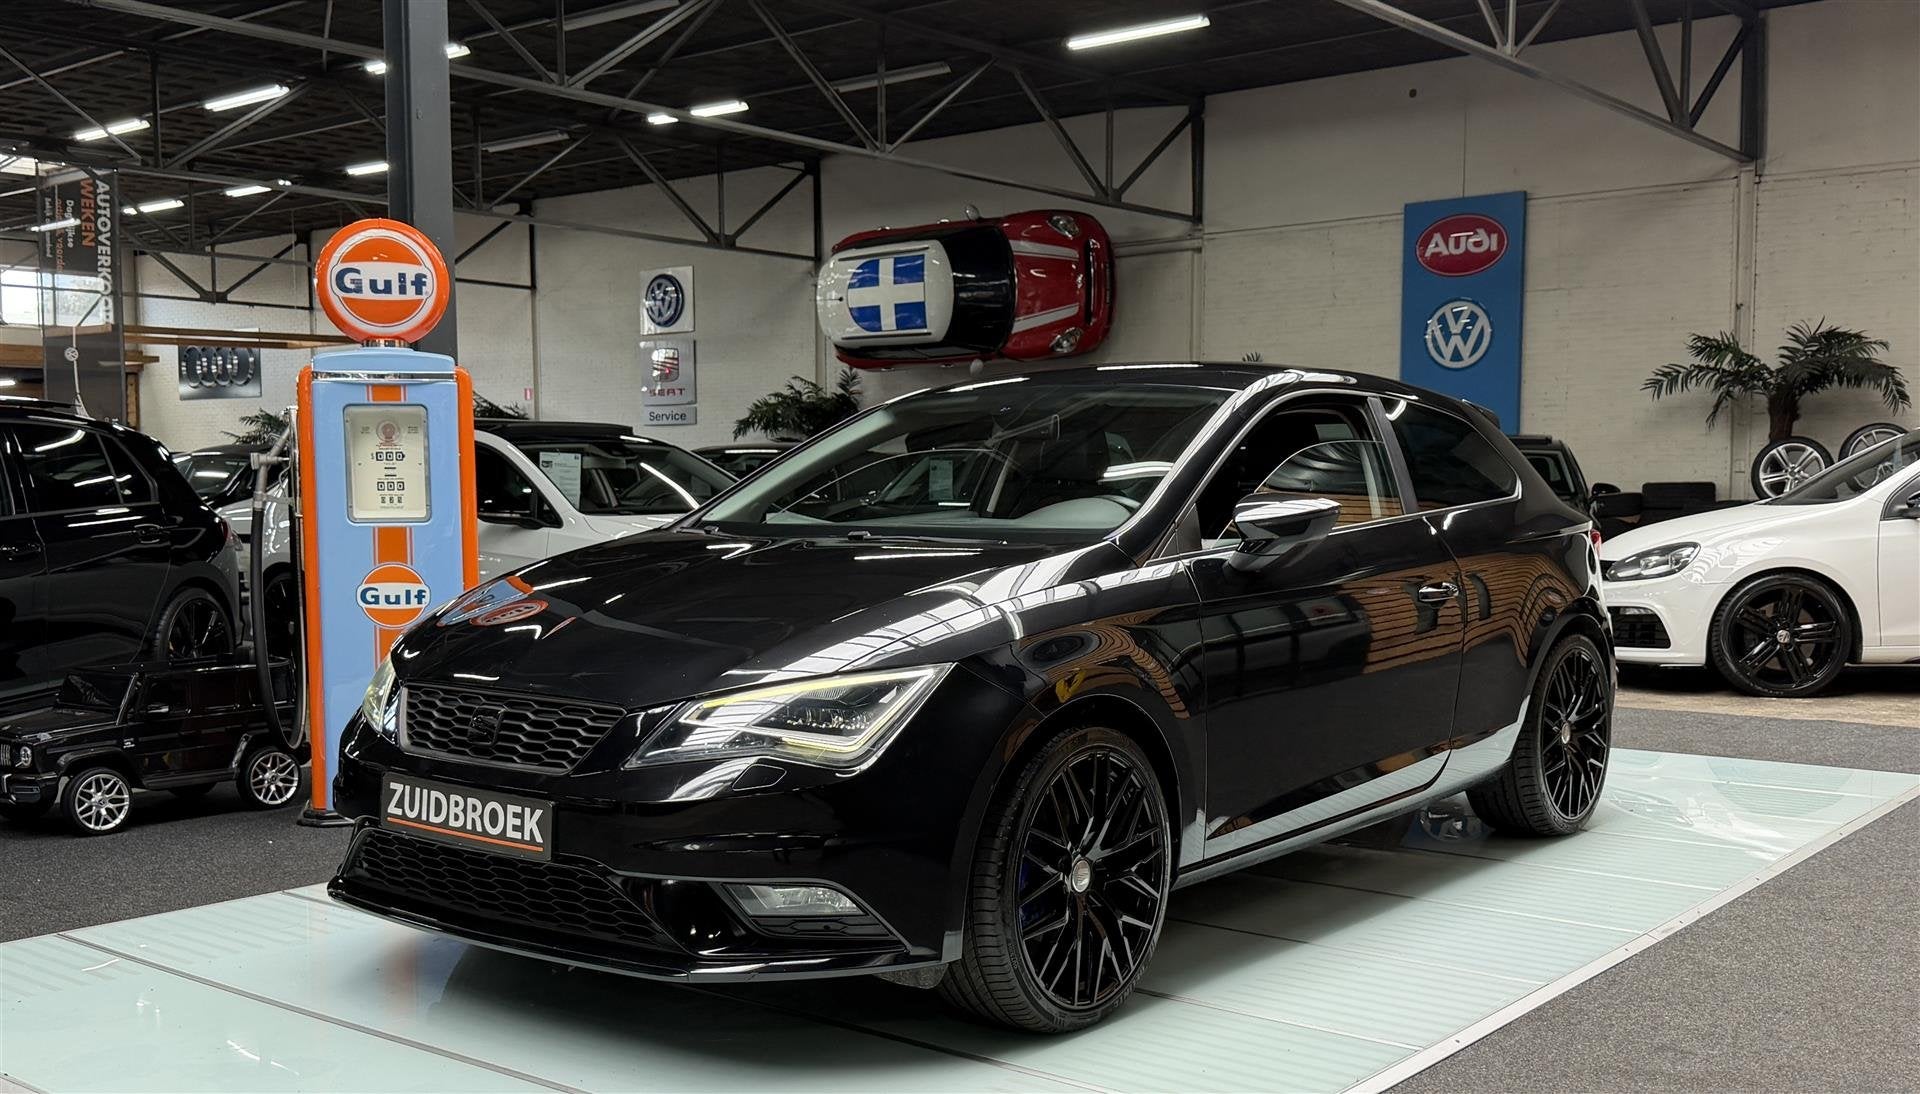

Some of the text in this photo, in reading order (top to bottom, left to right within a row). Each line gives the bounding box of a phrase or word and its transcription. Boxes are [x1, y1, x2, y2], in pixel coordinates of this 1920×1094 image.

[64, 200, 75, 248] Dagijkse
[80, 179, 96, 247] WEKEN
[335, 267, 428, 295] Gulf
[649, 388, 685, 397] SEAT
[649, 411, 687, 421] Service
[360, 587, 427, 605] Gulf
[387, 782, 544, 843] ZUIDBROEK
